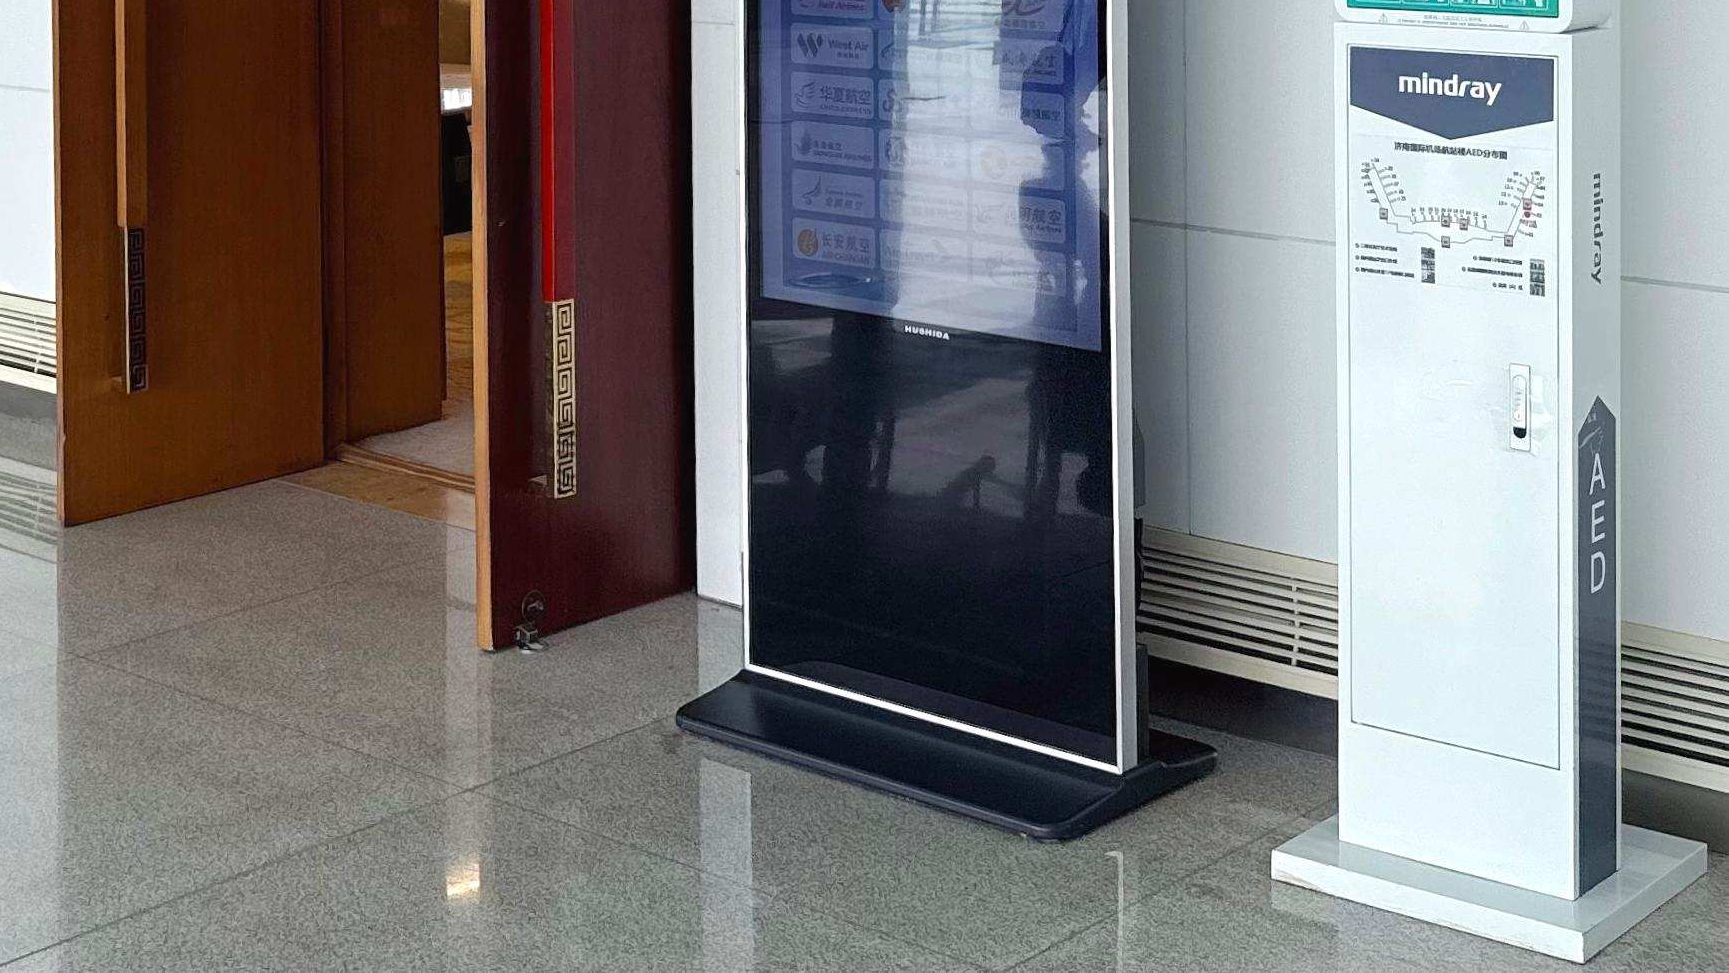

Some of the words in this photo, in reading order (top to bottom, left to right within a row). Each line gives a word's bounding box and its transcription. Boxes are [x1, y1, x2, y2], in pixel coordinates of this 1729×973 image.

[1398, 71, 1502, 106] mindray
[1590, 172, 1603, 285] mindray
[905, 325, 950, 340] HUSHIDA
[1589, 452, 1606, 594] AED
